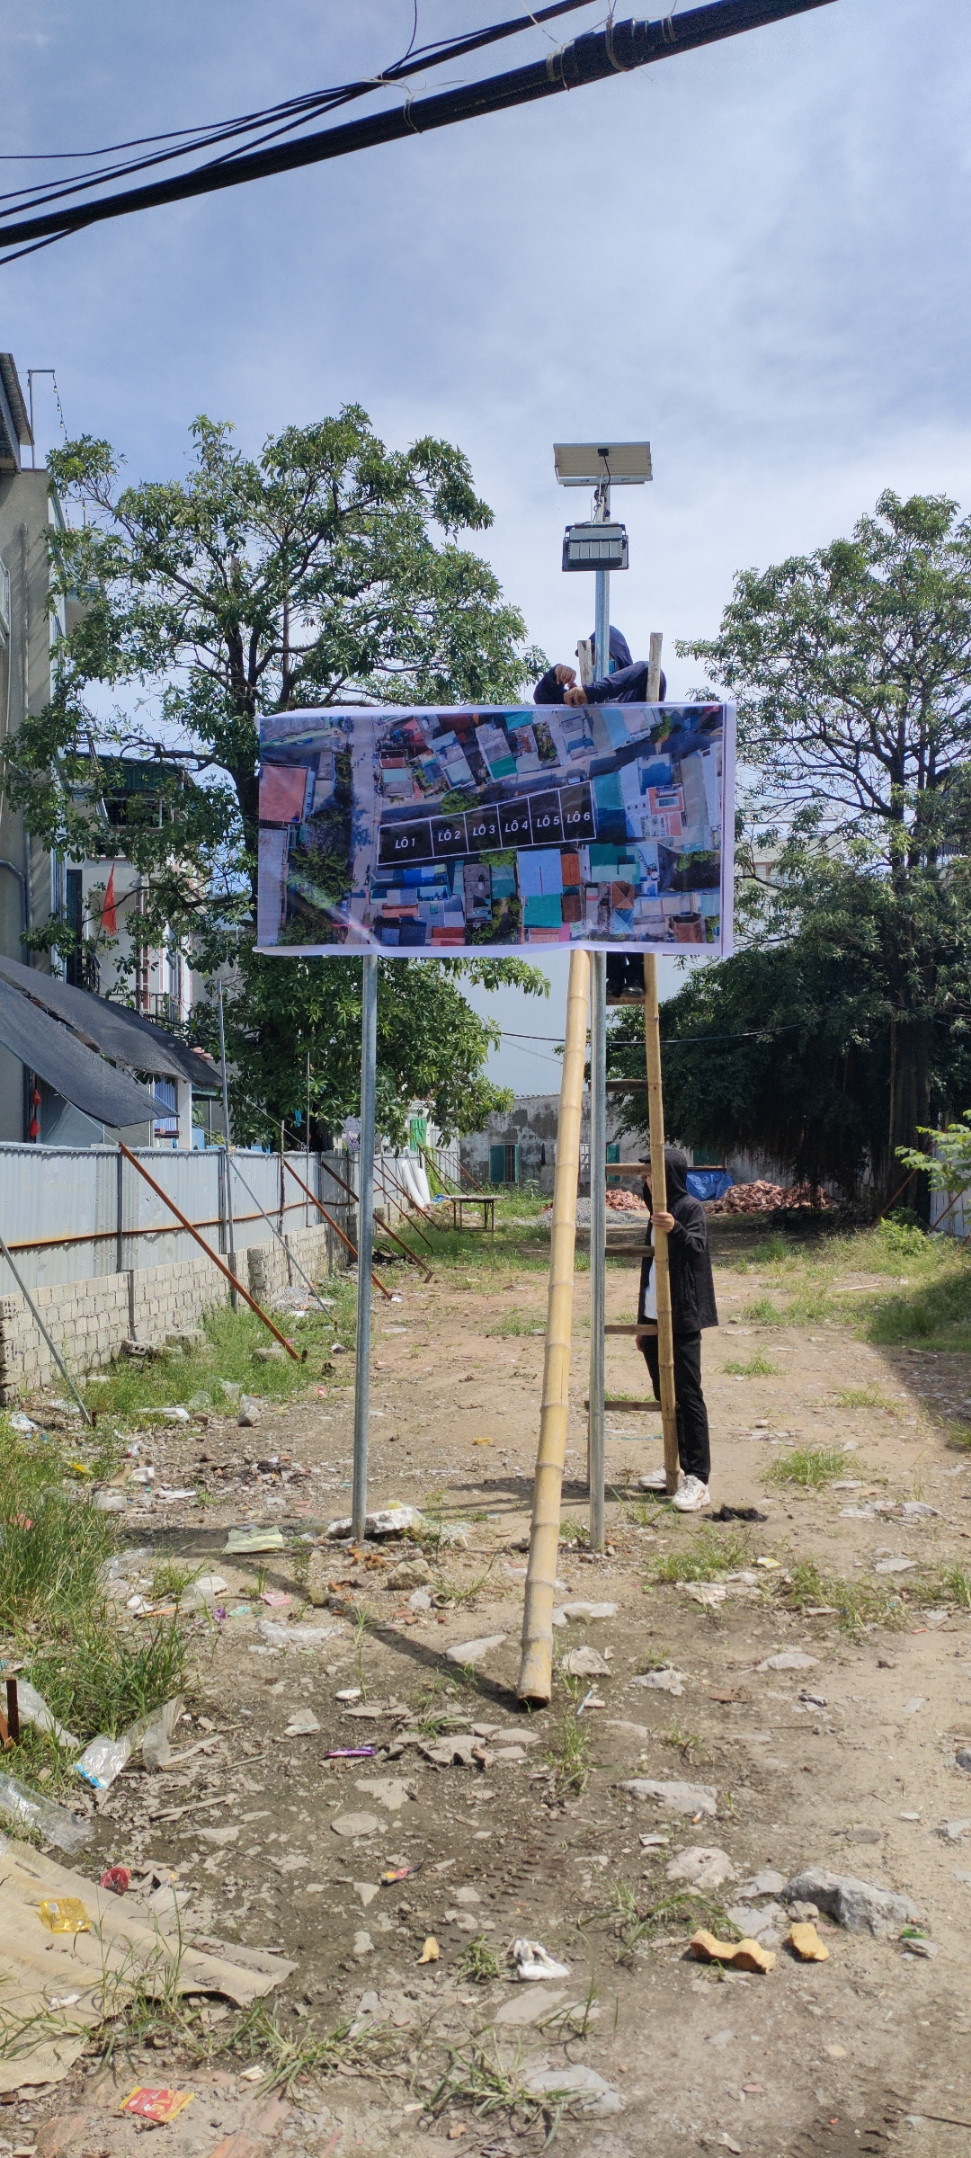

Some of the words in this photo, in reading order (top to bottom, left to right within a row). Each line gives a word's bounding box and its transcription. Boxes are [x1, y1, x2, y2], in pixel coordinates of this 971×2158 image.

[536, 815, 550, 828] LÔ
[553, 816, 560, 826] 5
[566, 811, 581, 824] LÔ
[583, 811, 590, 821] 6
[472, 824, 487, 837] LÔ
[489, 824, 496, 834] 3
[505, 820, 519, 833] LÔ
[521, 820, 529, 830] 4
[395, 836, 409, 849] LÔ
[412, 837, 416, 847] 1
[438, 830, 452, 842] LÔ
[454, 830, 461, 840] 2
